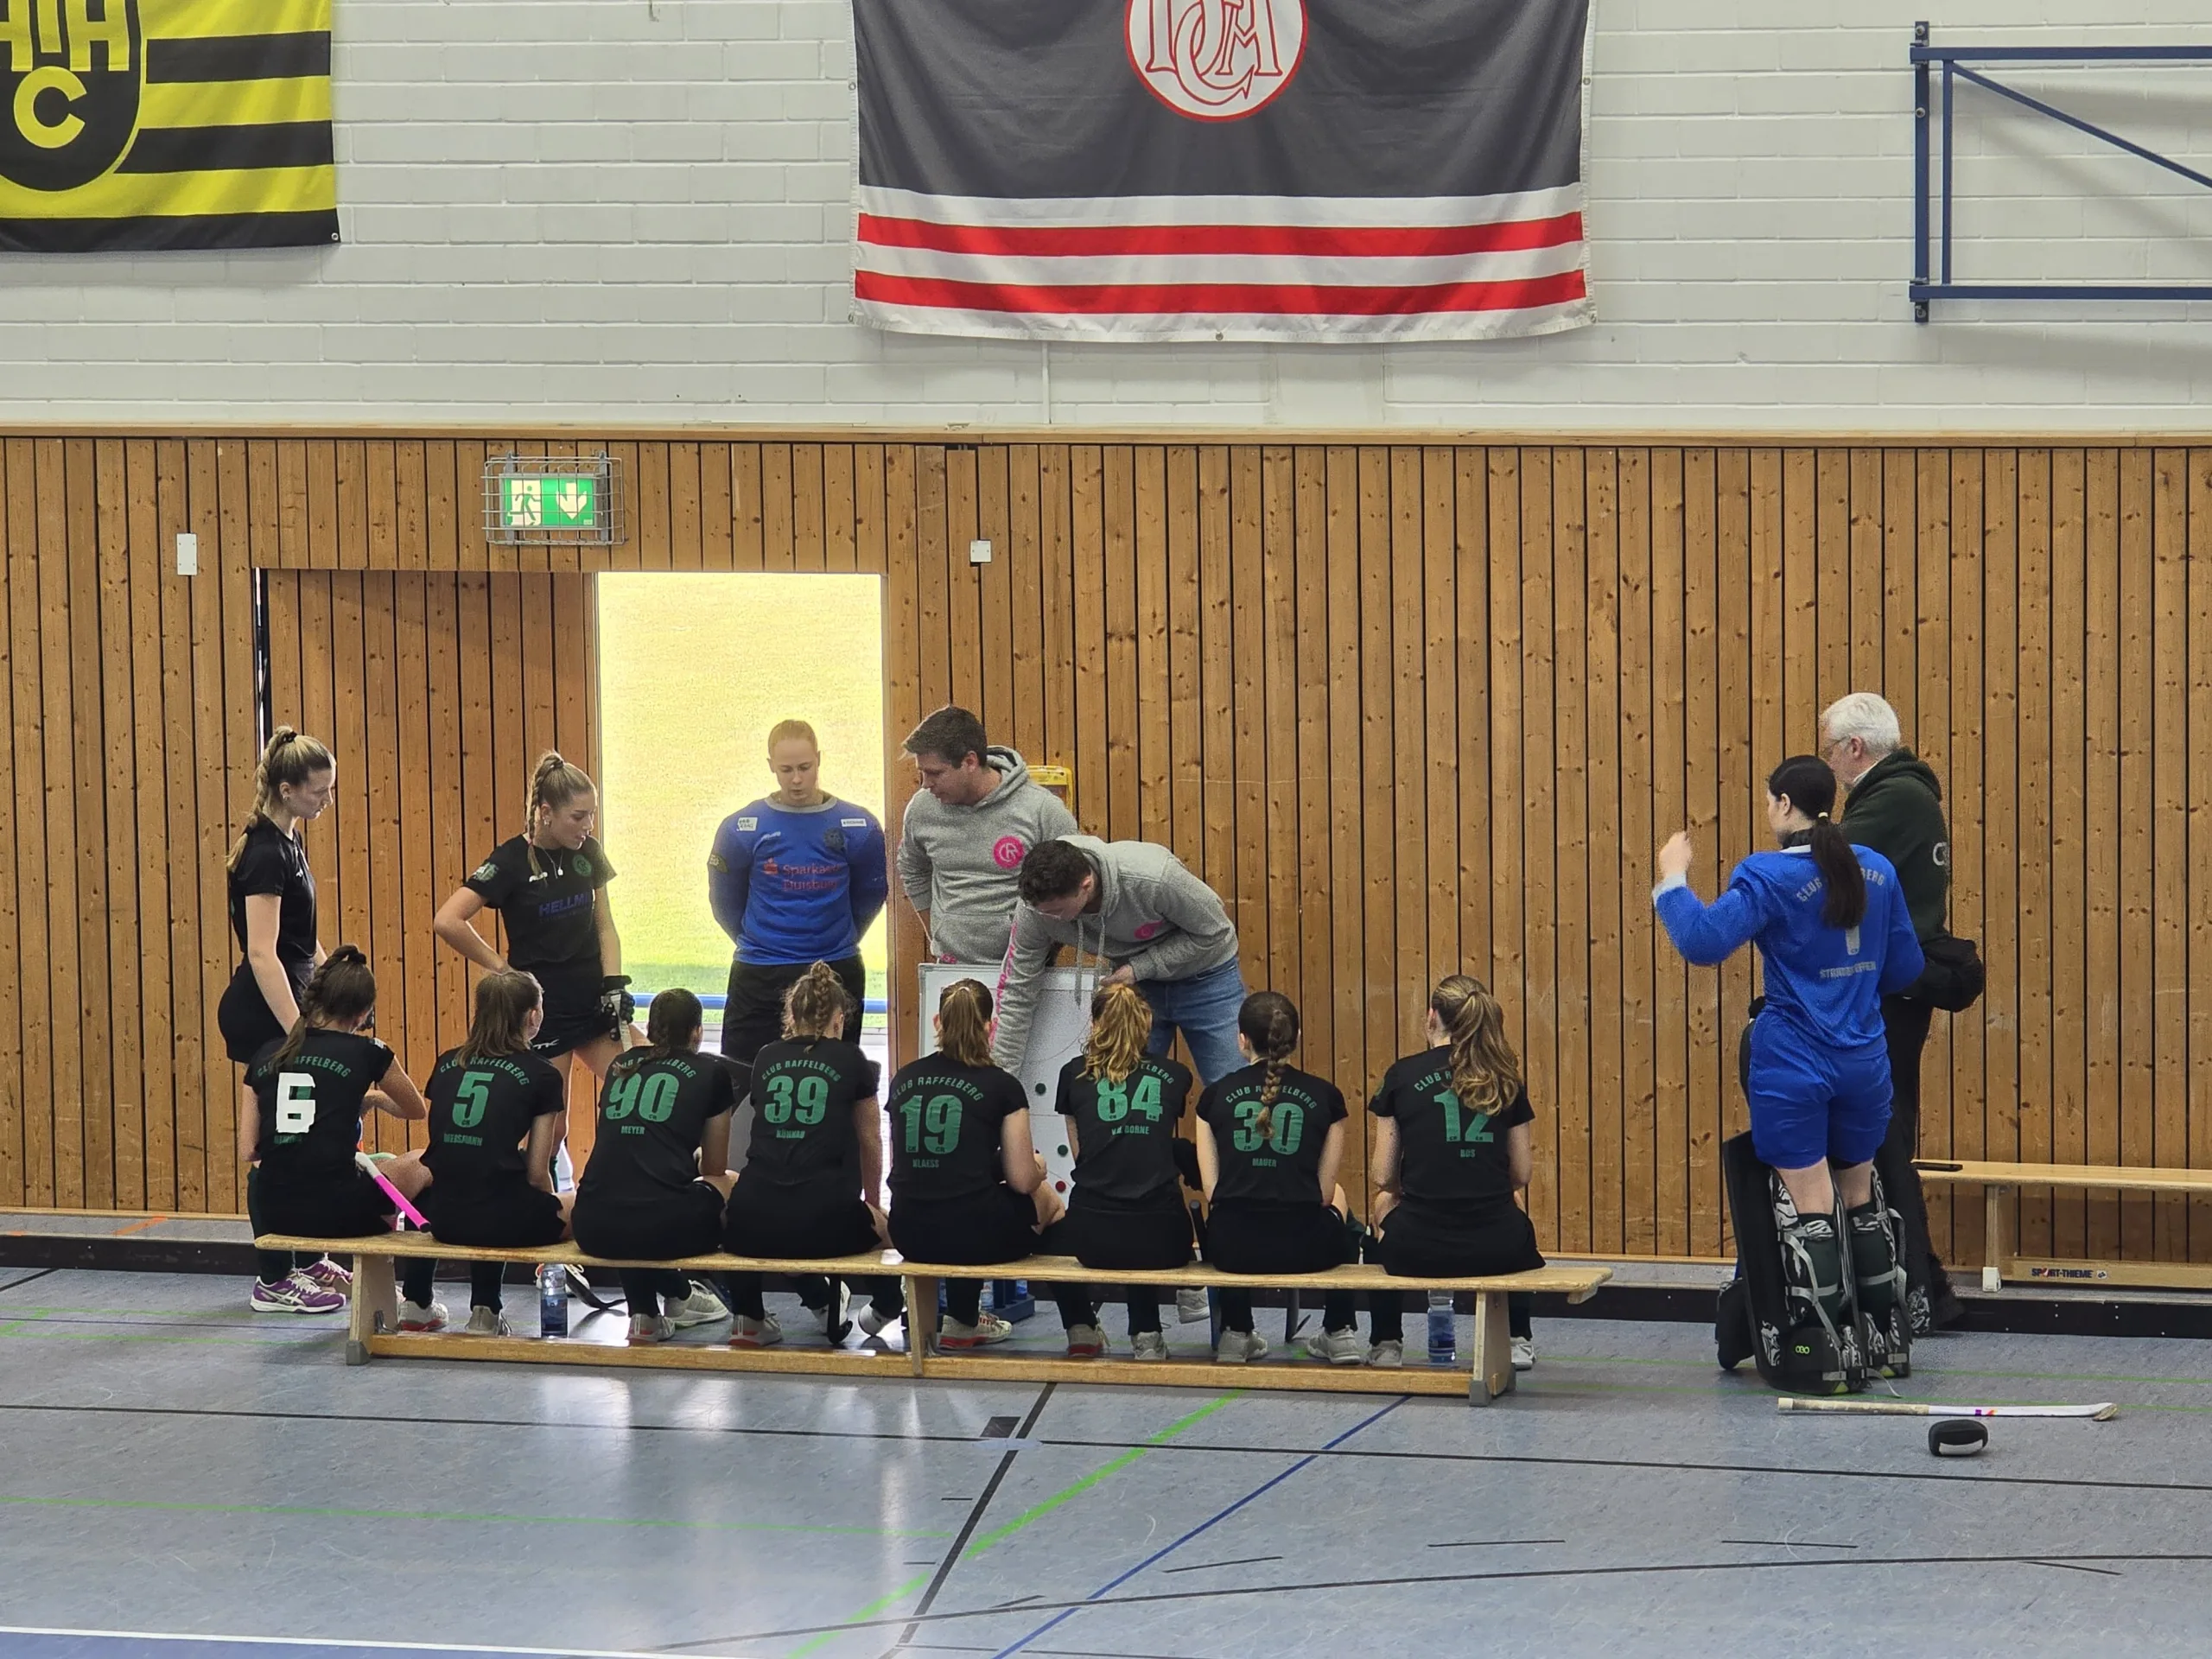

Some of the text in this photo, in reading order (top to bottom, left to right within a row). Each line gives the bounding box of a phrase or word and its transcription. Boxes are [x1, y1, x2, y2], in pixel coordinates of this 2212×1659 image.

[295, 1055, 352, 1077] AFFELBERG
[762, 1059, 842, 1083] CLUB RAFFELBERG
[892, 1076, 984, 1102] CLUB RAFFELBERG
[1414, 1071, 1441, 1092] CLUB
[276, 1072, 316, 1134] 6
[452, 1071, 495, 1128] 5
[606, 1071, 680, 1122] 90
[764, 1075, 830, 1125] 39
[1096, 1074, 1164, 1122] 84
[1225, 1085, 1251, 1103] CLUB
[1433, 1088, 1494, 1143] 12
[620, 1125, 645, 1135] MEYER
[899, 1094, 963, 1154] 19
[1233, 1100, 1305, 1155] 30
